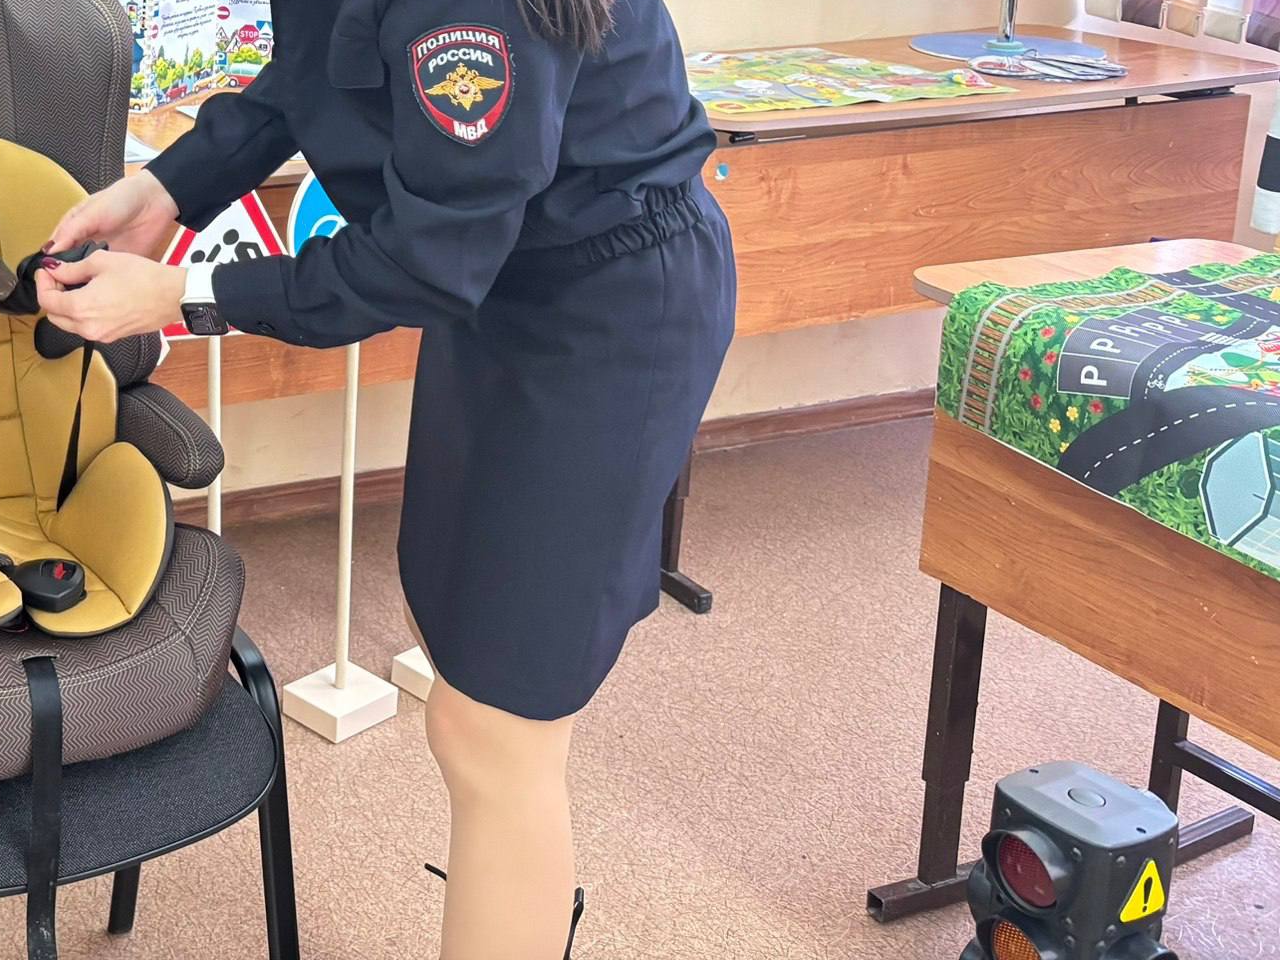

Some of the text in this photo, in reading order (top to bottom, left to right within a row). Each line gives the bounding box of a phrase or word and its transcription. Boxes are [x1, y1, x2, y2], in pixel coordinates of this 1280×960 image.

[240, 30, 258, 38] STOP
[416, 30, 500, 59] ПОЛИЦИЯ
[428, 48, 494, 73] РОССИЯ
[453, 118, 488, 140] МВД
[1090, 338, 1121, 354] P
[1081, 365, 1107, 386] P
